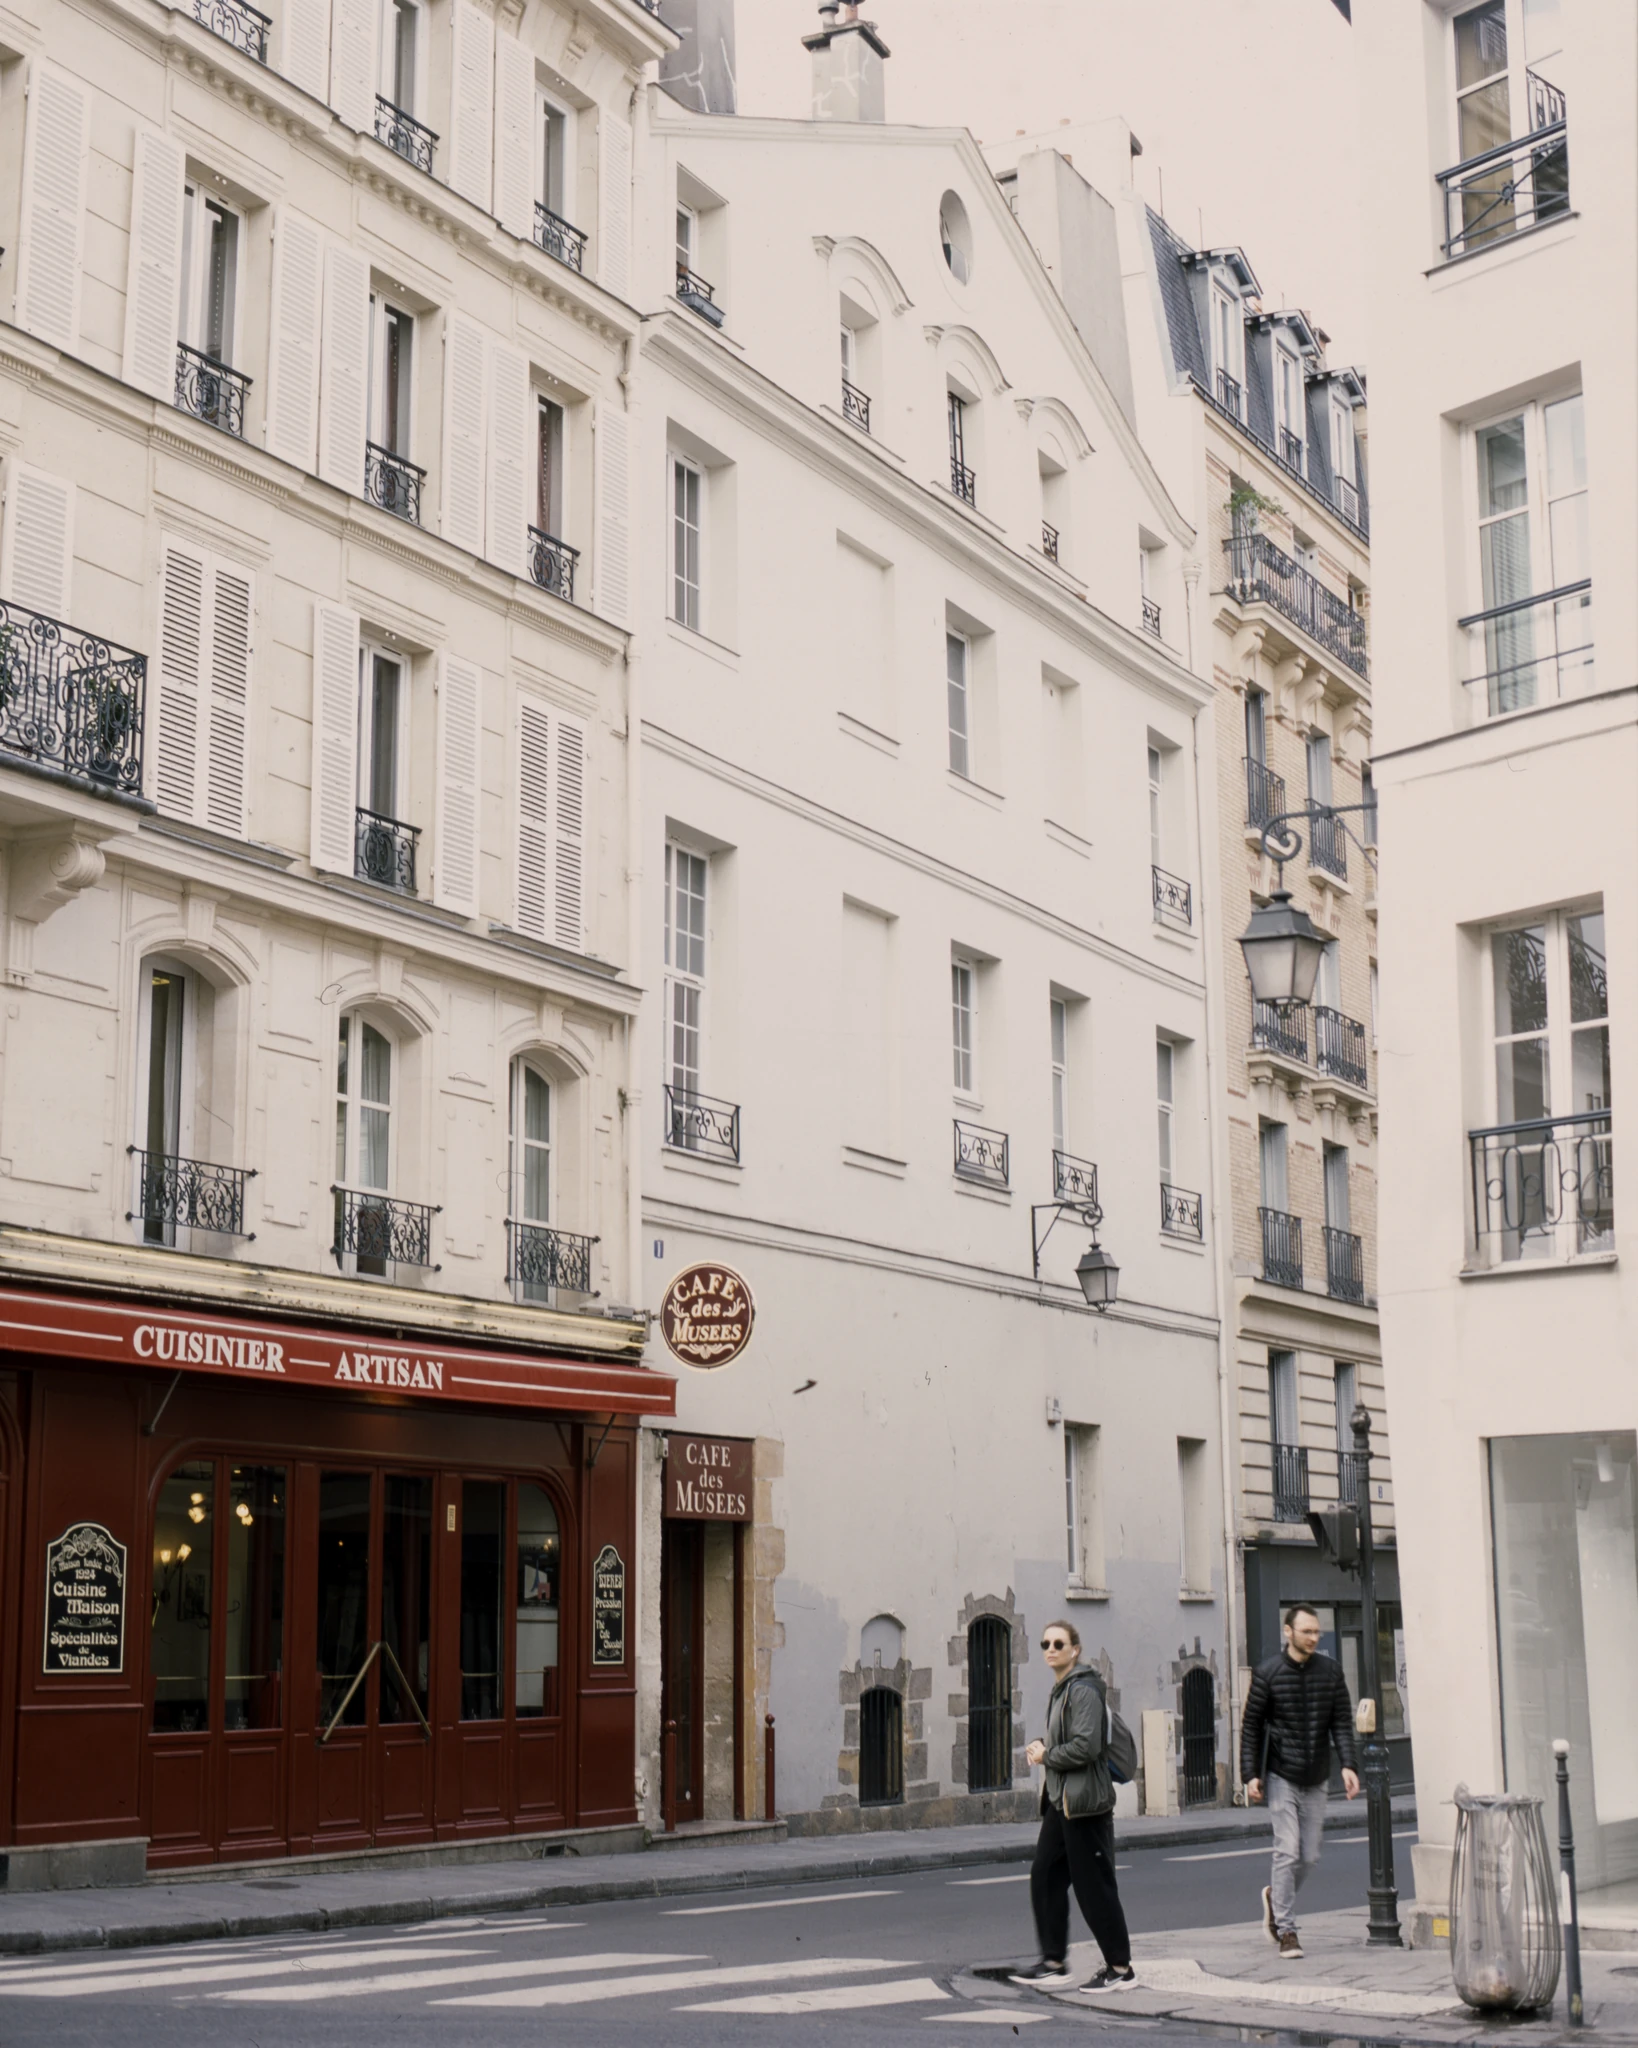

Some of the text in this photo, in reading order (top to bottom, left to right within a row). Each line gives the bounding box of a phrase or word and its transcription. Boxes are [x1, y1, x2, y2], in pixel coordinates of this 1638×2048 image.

[673, 1273, 738, 1301] CAFE
[691, 1298, 721, 1317] des
[671, 1318, 742, 1342] MUSEES
[133, 1325, 444, 1390] CUISINIER ARTISAN
[686, 1443, 731, 1467] CAFE
[699, 1468, 723, 1488] des
[676, 1480, 746, 1515] MUSEES
[75, 1569, 96, 1580] 1924
[53, 1581, 107, 1597] Cuisine
[67, 1599, 120, 1615] Maison
[596, 1597, 621, 1608] Pression
[50, 1631, 118, 1647] Spécialités
[78, 1646, 89, 1654] de
[58, 1653, 109, 1666] Viandes
